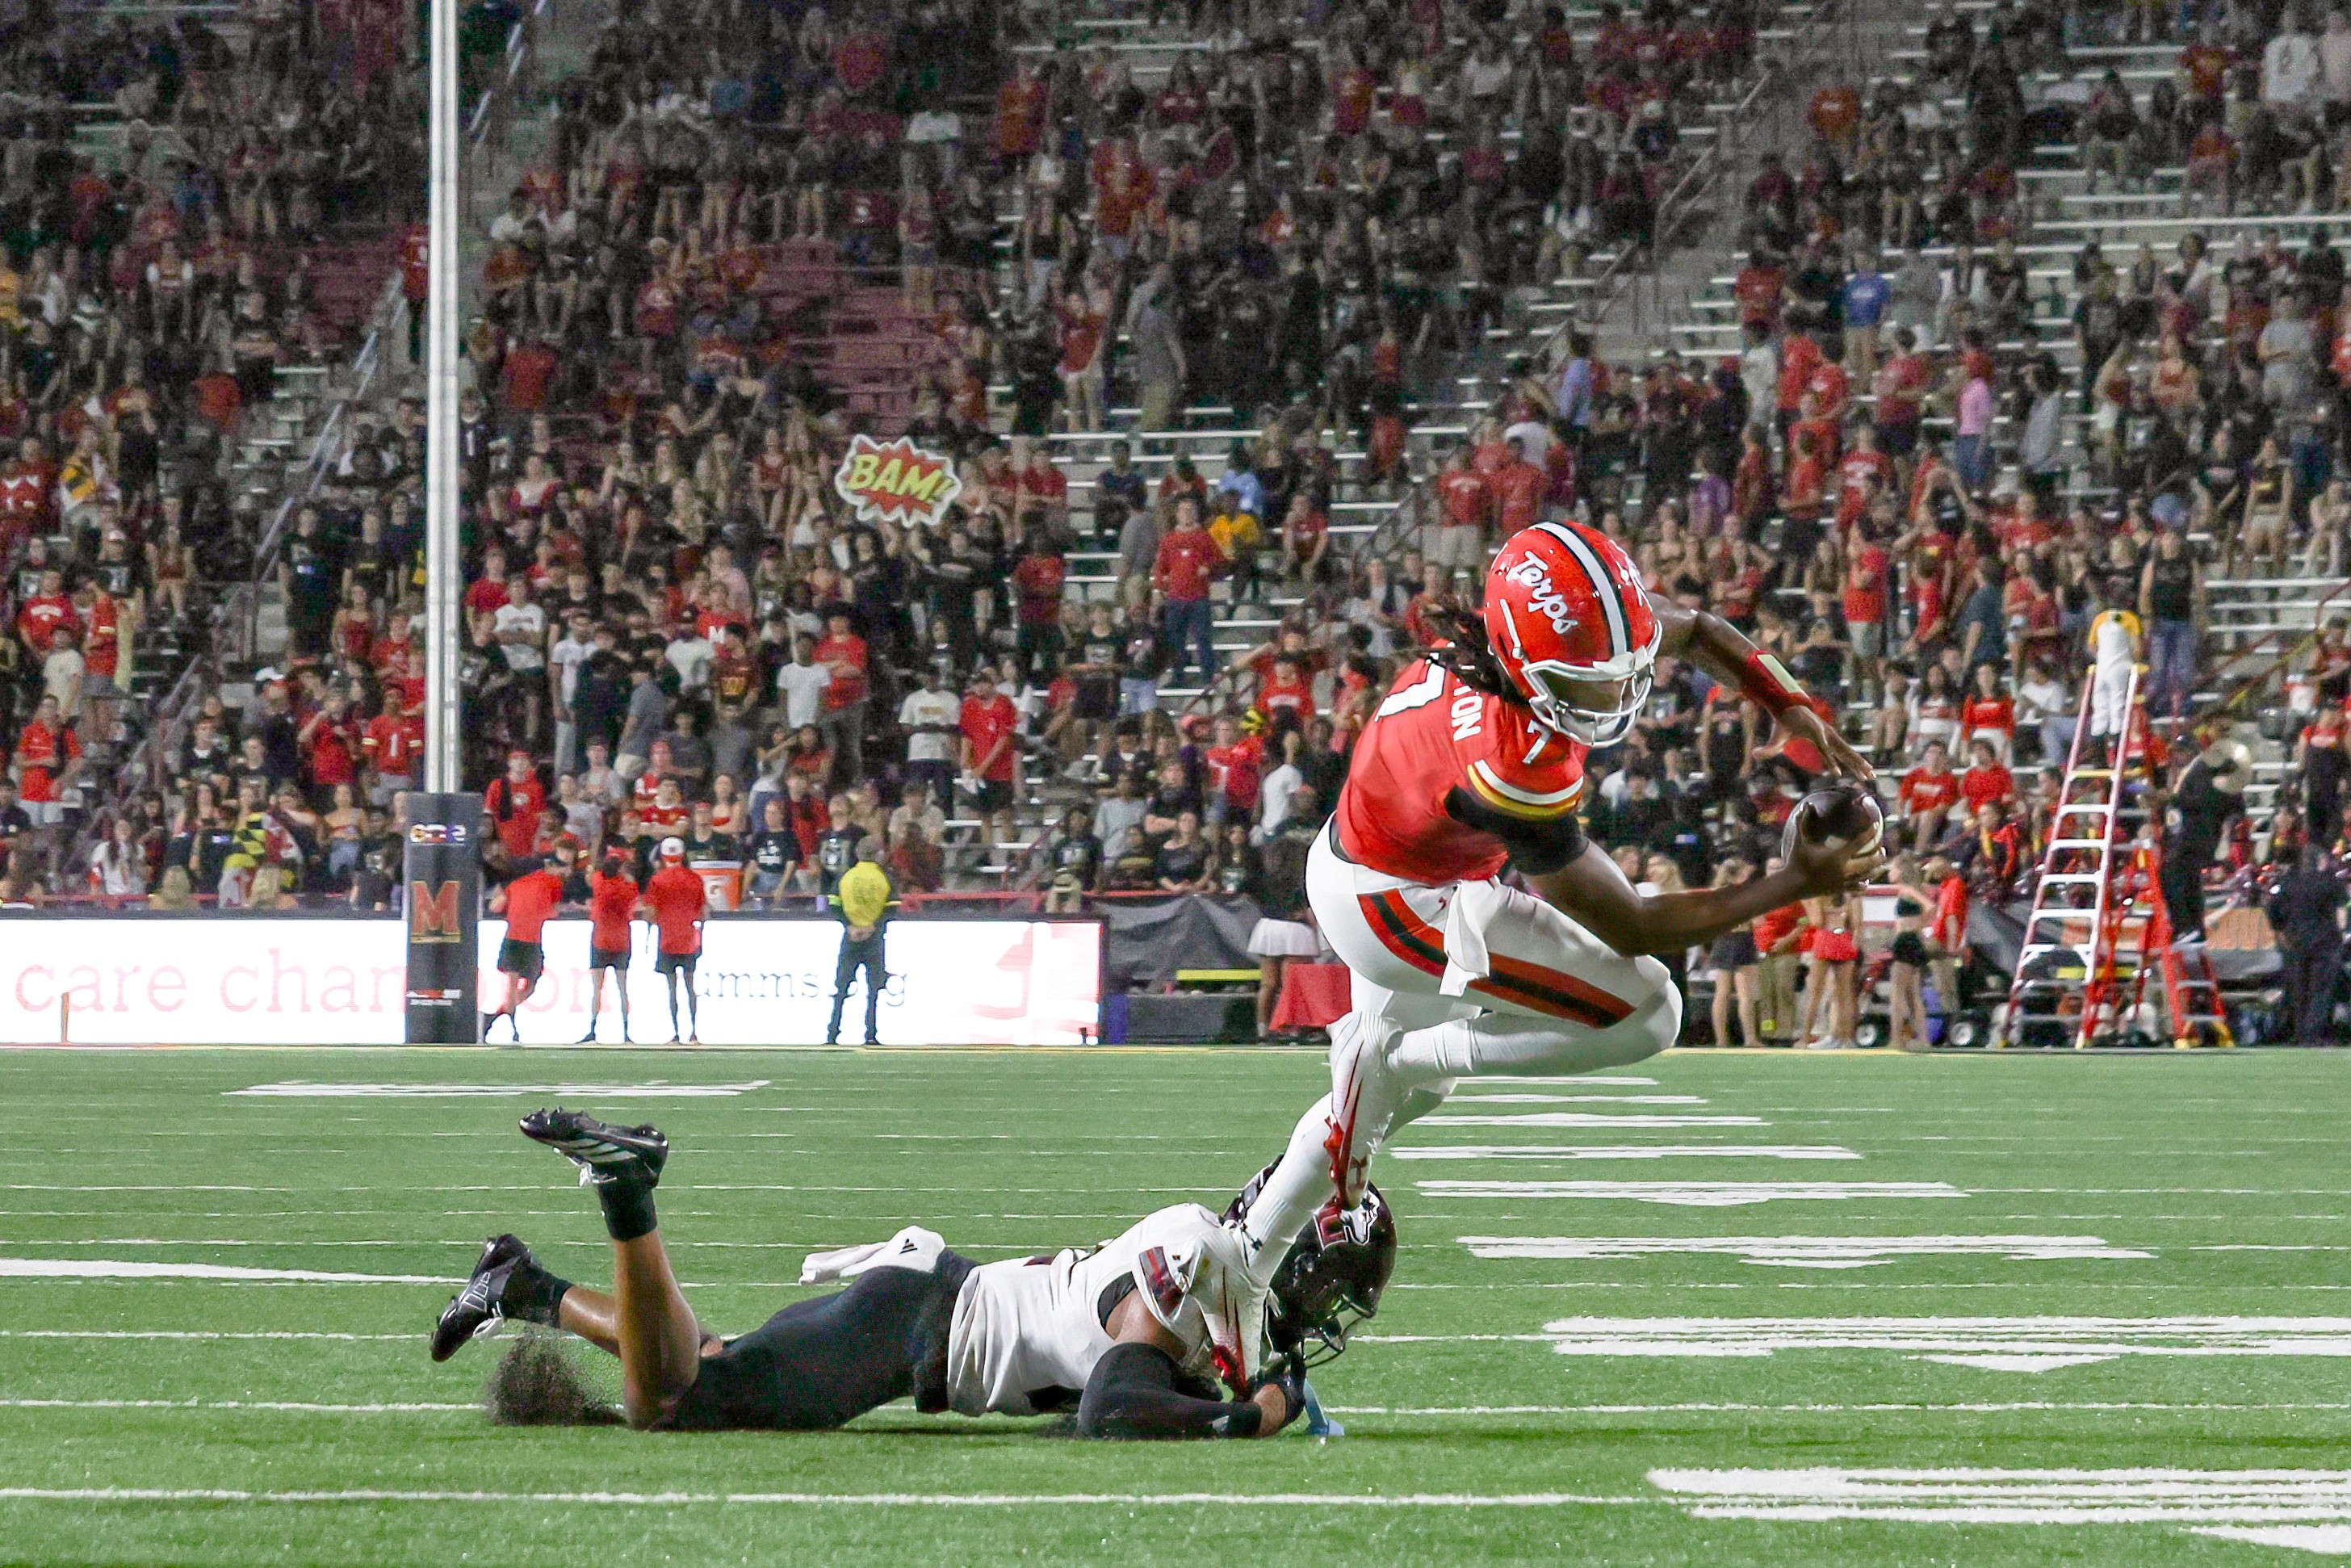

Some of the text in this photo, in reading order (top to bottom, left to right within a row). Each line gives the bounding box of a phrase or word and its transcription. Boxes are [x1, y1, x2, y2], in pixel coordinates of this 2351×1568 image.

[848, 454, 955, 504] BAM!
[1505, 551, 1578, 635] Terps
[1522, 719, 1553, 765] 7
[411, 880, 461, 943] M
[15, 965, 187, 1012] care
